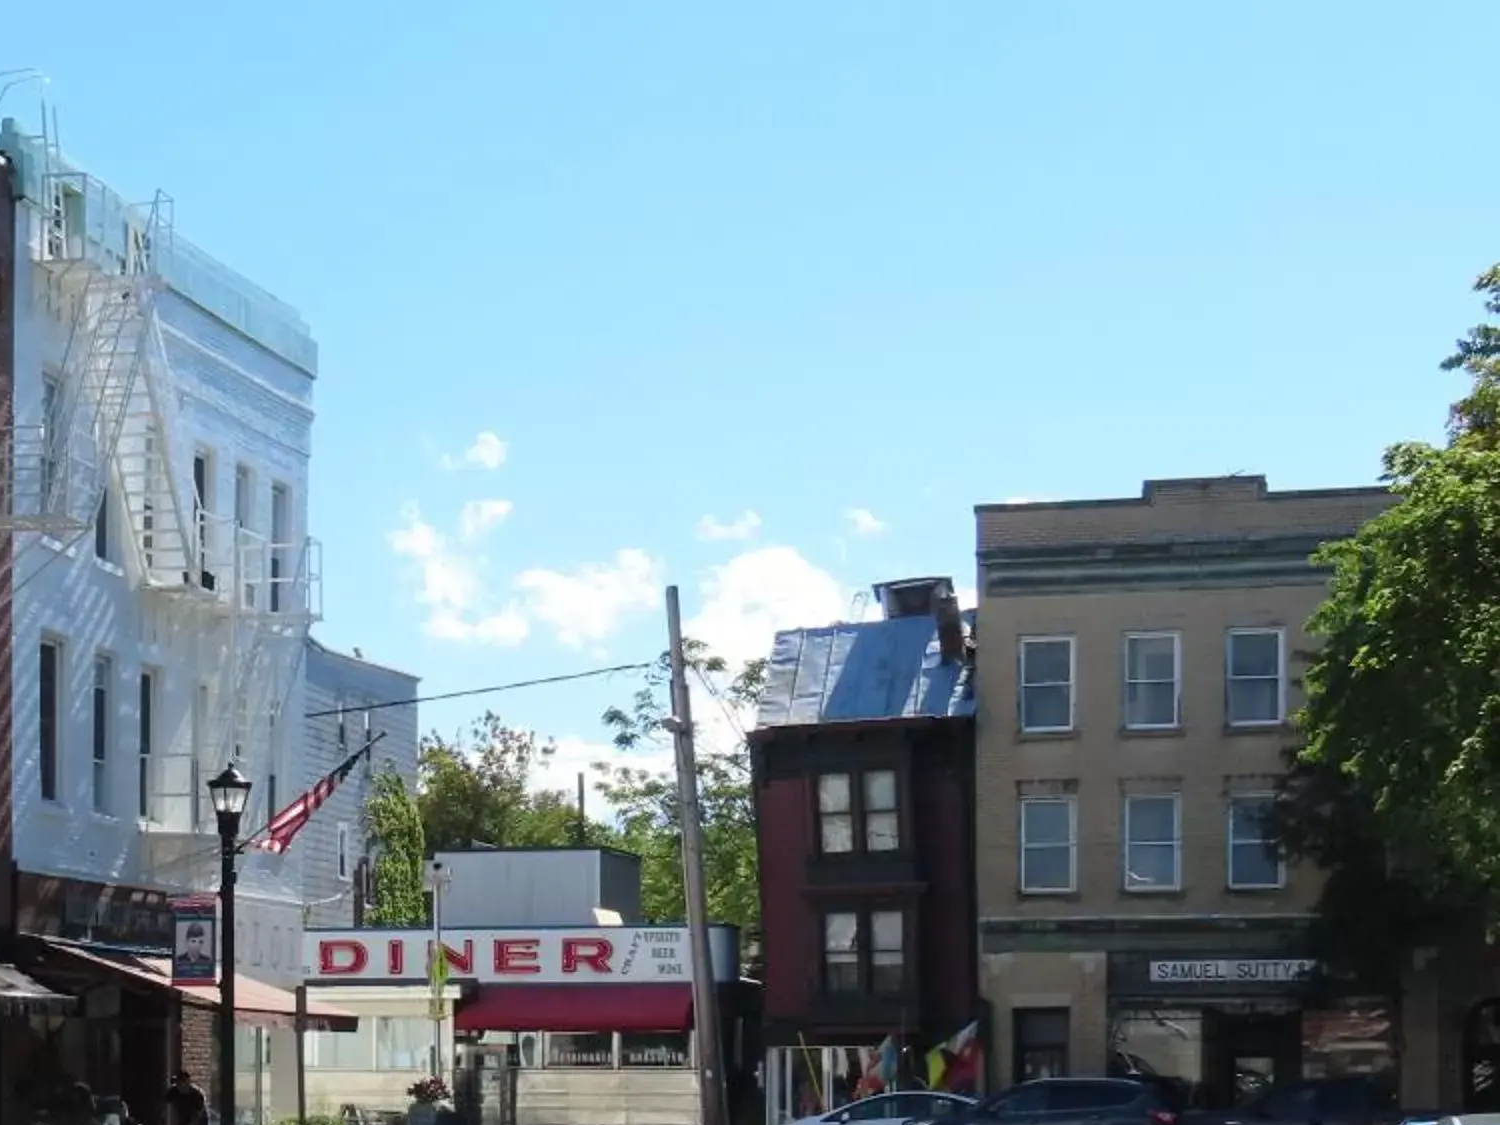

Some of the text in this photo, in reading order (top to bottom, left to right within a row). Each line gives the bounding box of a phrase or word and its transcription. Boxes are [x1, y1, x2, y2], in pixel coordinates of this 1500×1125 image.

[319, 937, 614, 975] DINER
[651, 947, 676, 959] BEER
[1156, 962, 1227, 979] SAMUEL
